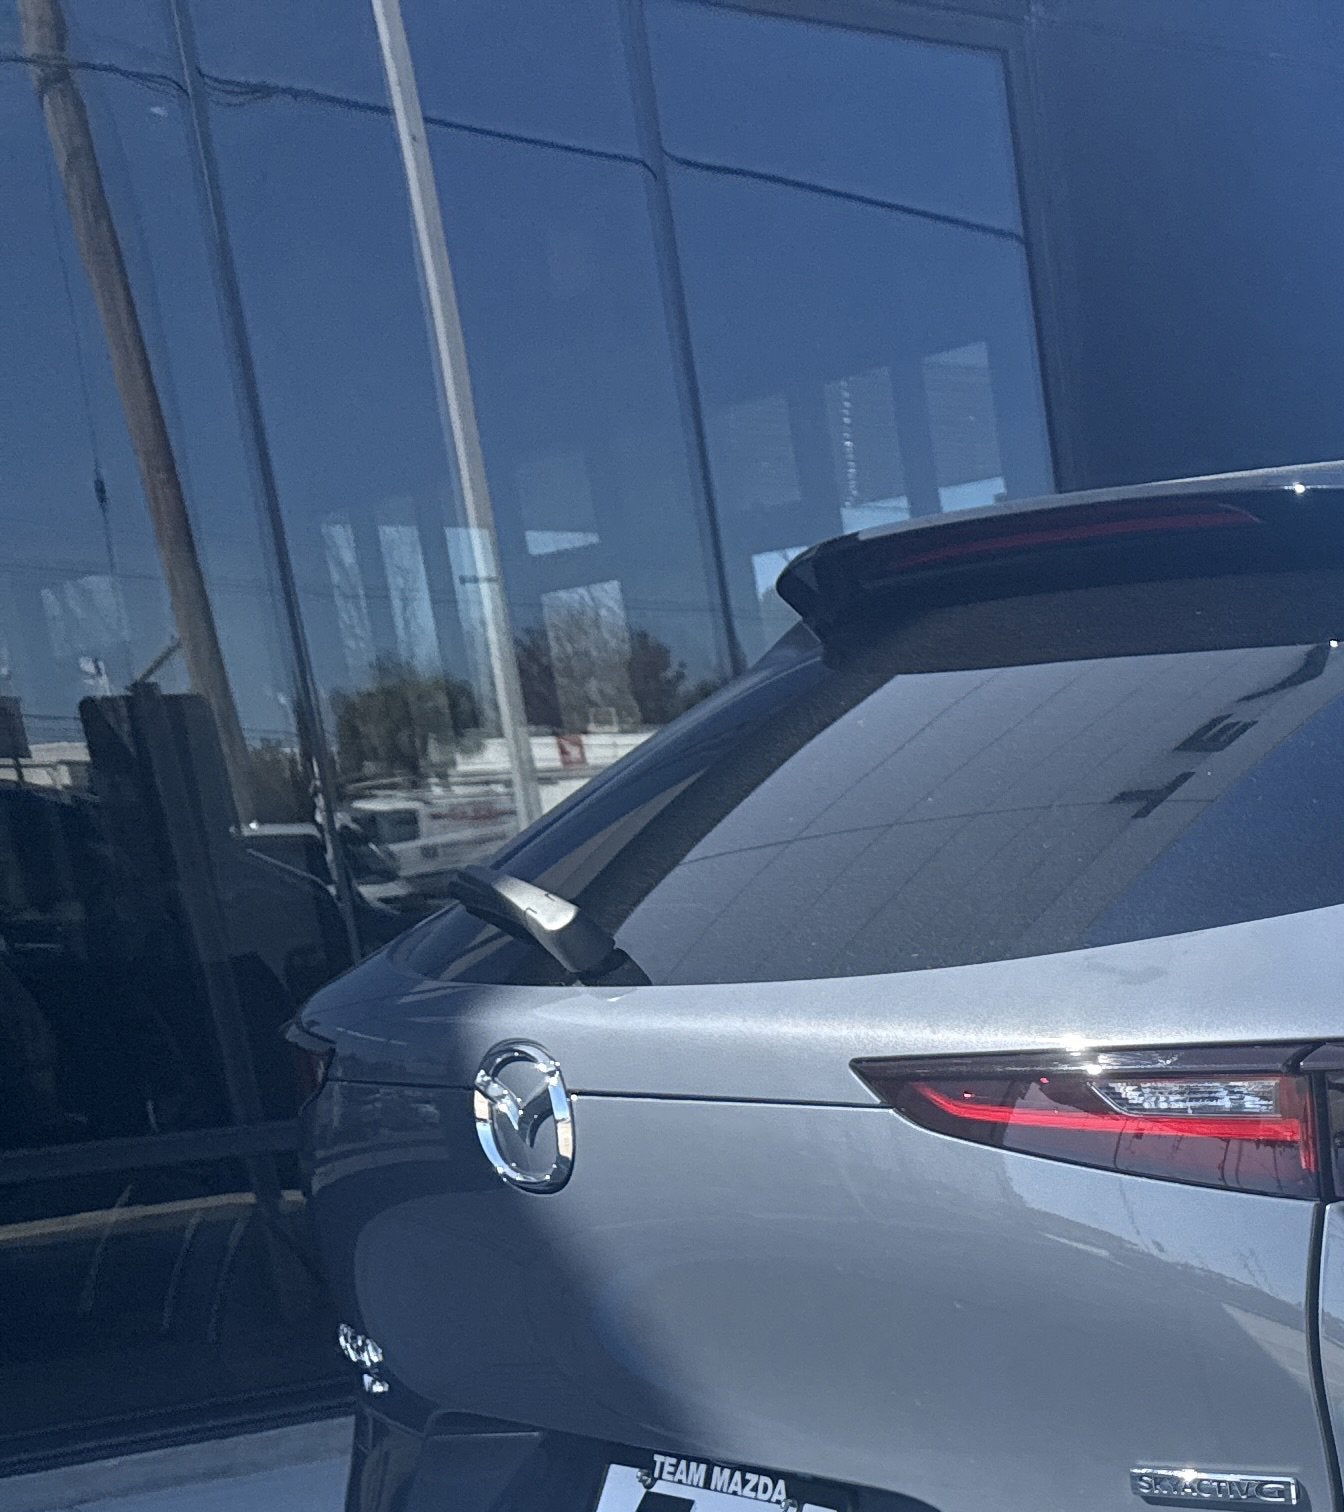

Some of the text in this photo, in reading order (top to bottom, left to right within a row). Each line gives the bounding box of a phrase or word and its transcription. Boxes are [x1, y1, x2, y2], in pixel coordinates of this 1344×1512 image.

[653, 1454, 788, 1502] TEAM MAZDA
[1253, 1482, 1287, 1502] G
